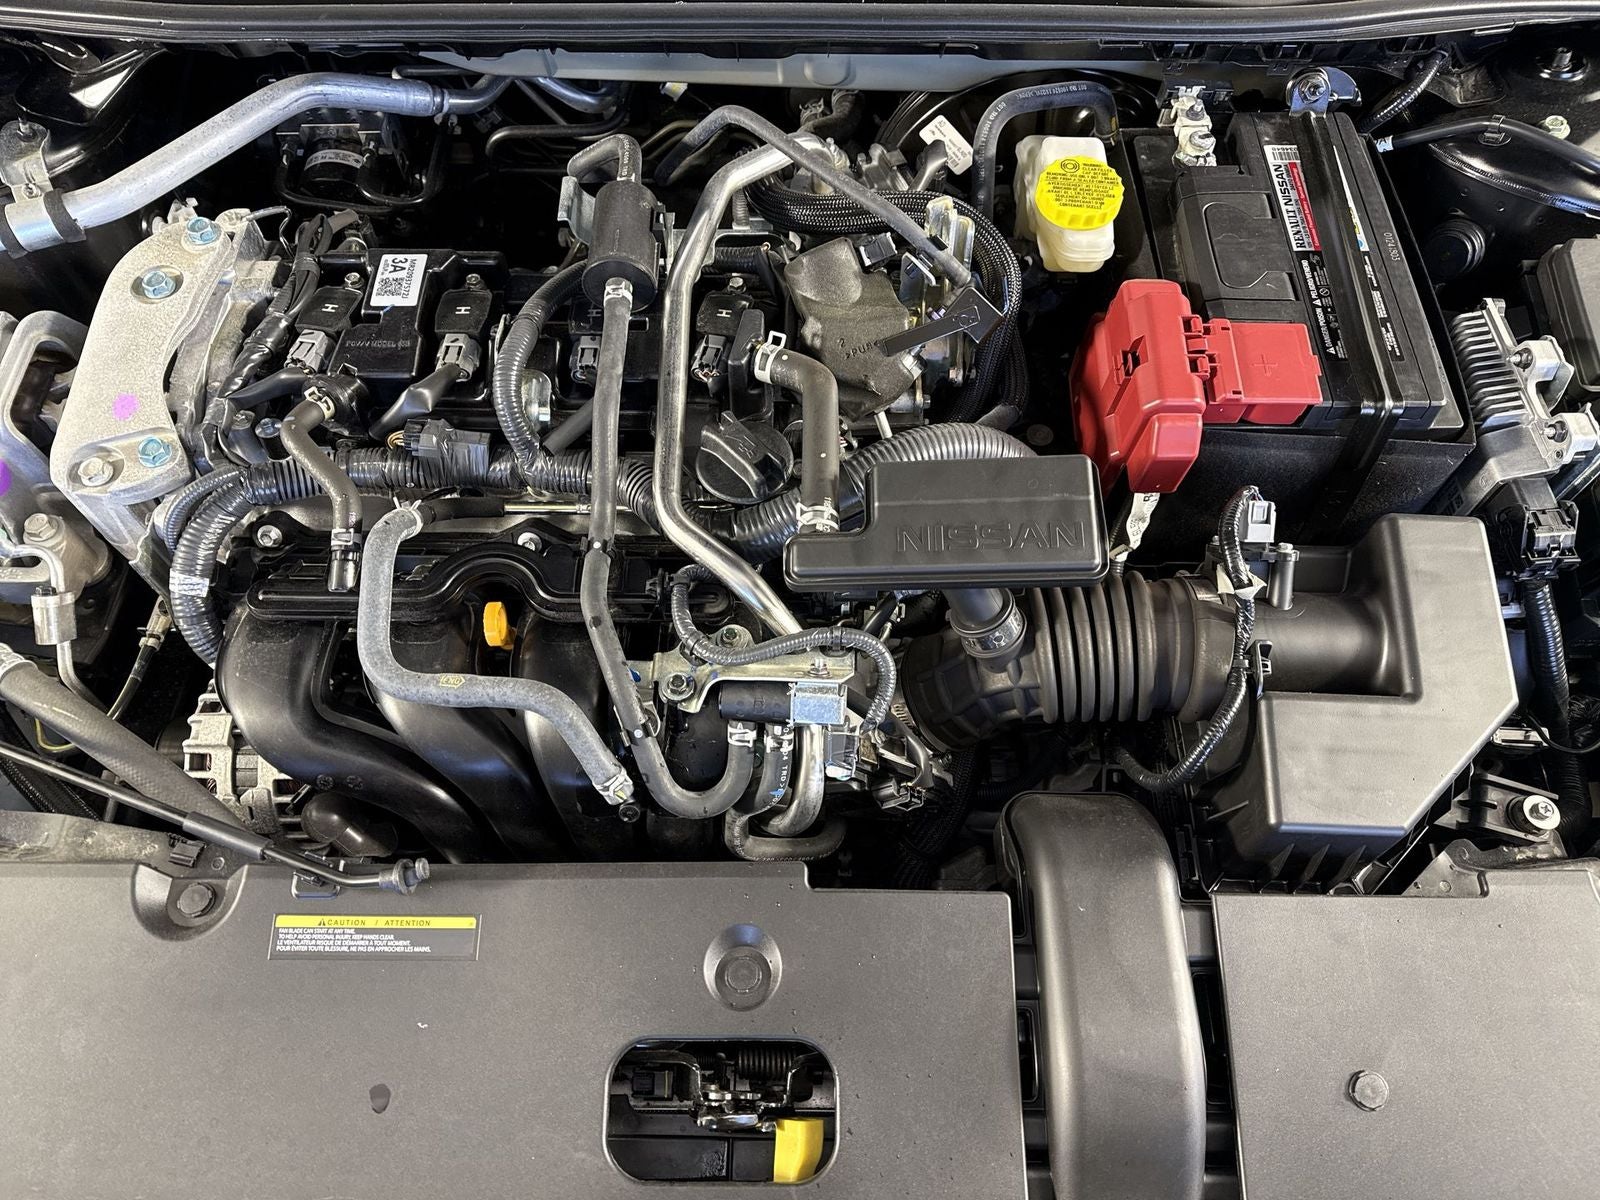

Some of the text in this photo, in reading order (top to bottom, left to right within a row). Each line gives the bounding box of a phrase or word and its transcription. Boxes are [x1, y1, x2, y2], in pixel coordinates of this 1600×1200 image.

[1272, 164, 1306, 249] RENAULT NISSAN
[389, 257, 408, 274] 3A
[896, 520, 1086, 552] NISSAN
